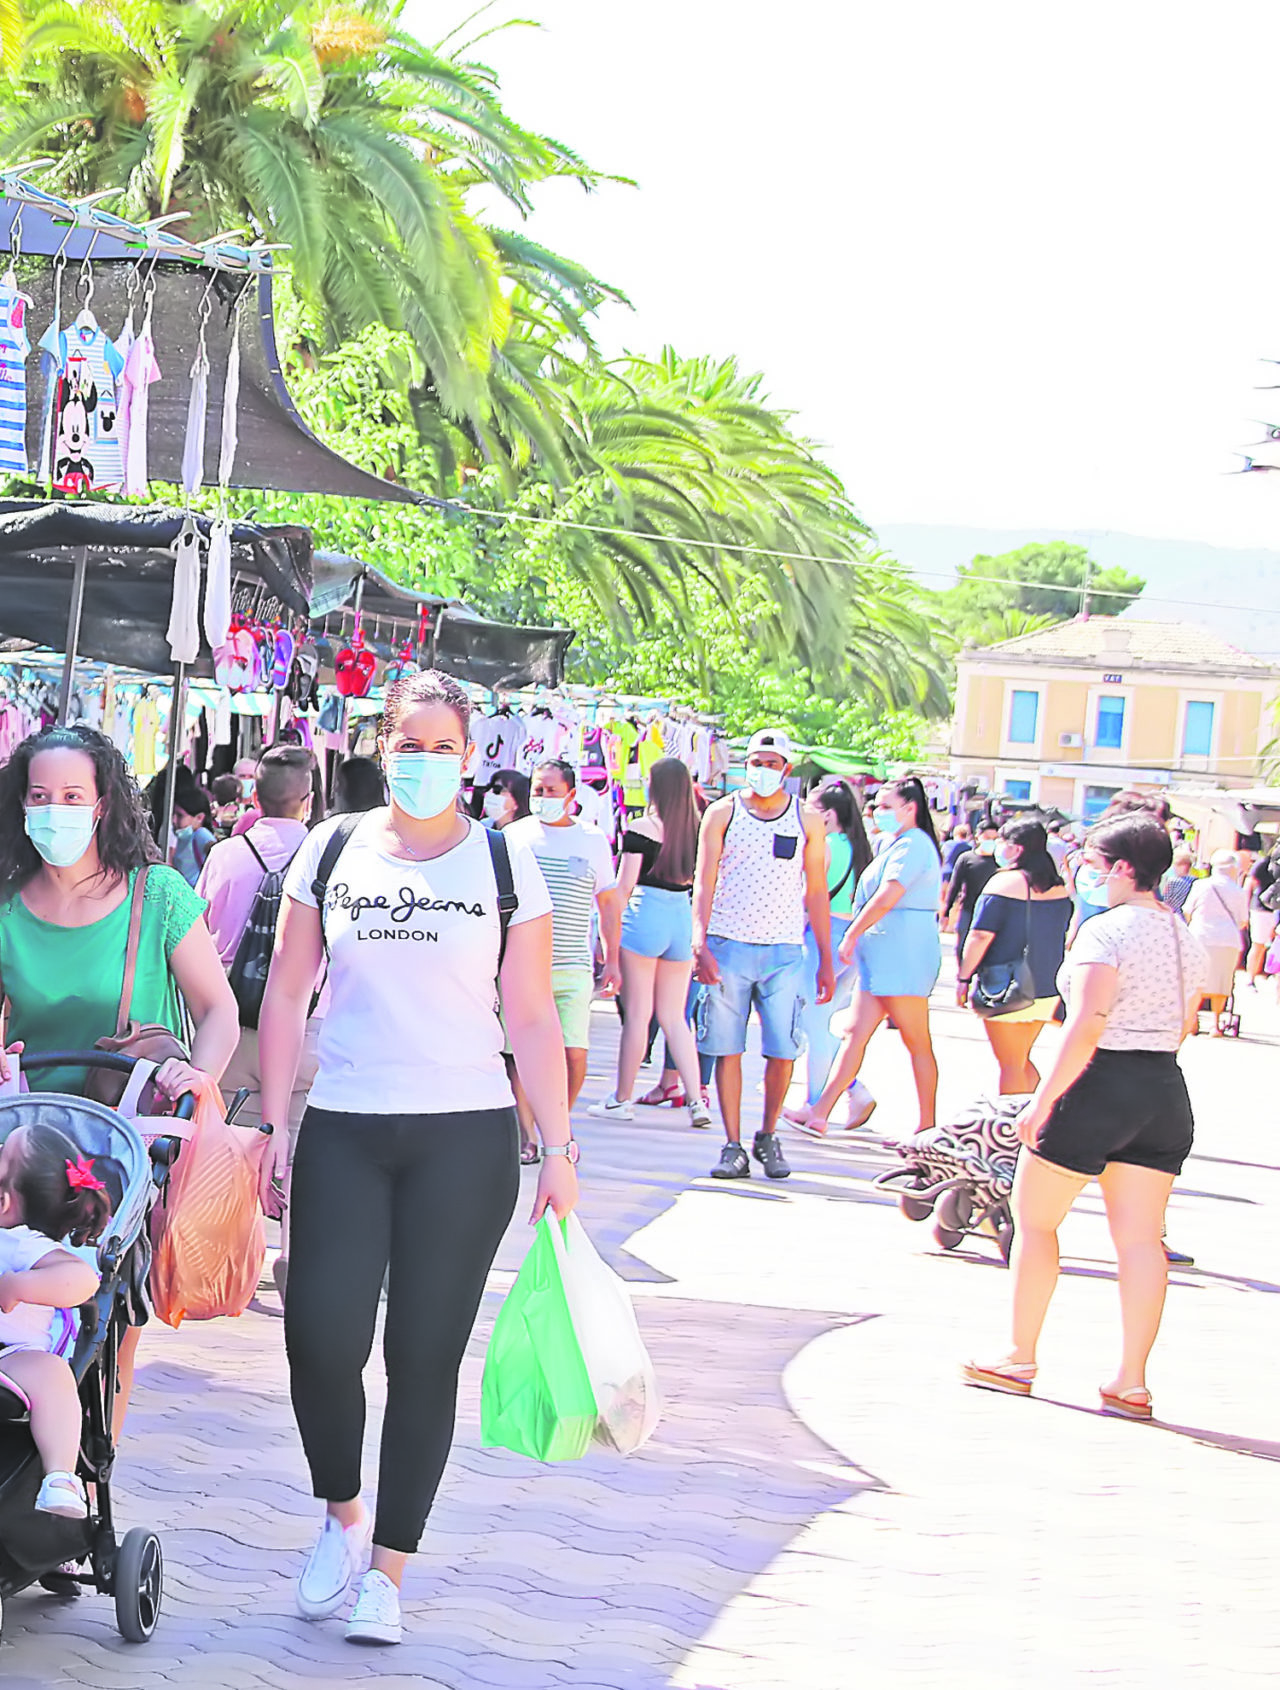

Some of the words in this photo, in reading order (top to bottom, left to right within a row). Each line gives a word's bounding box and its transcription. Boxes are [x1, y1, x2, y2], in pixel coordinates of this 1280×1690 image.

[327, 883, 390, 921] Pepe
[391, 886, 486, 922] Jeans
[357, 929, 438, 943] LONDON
